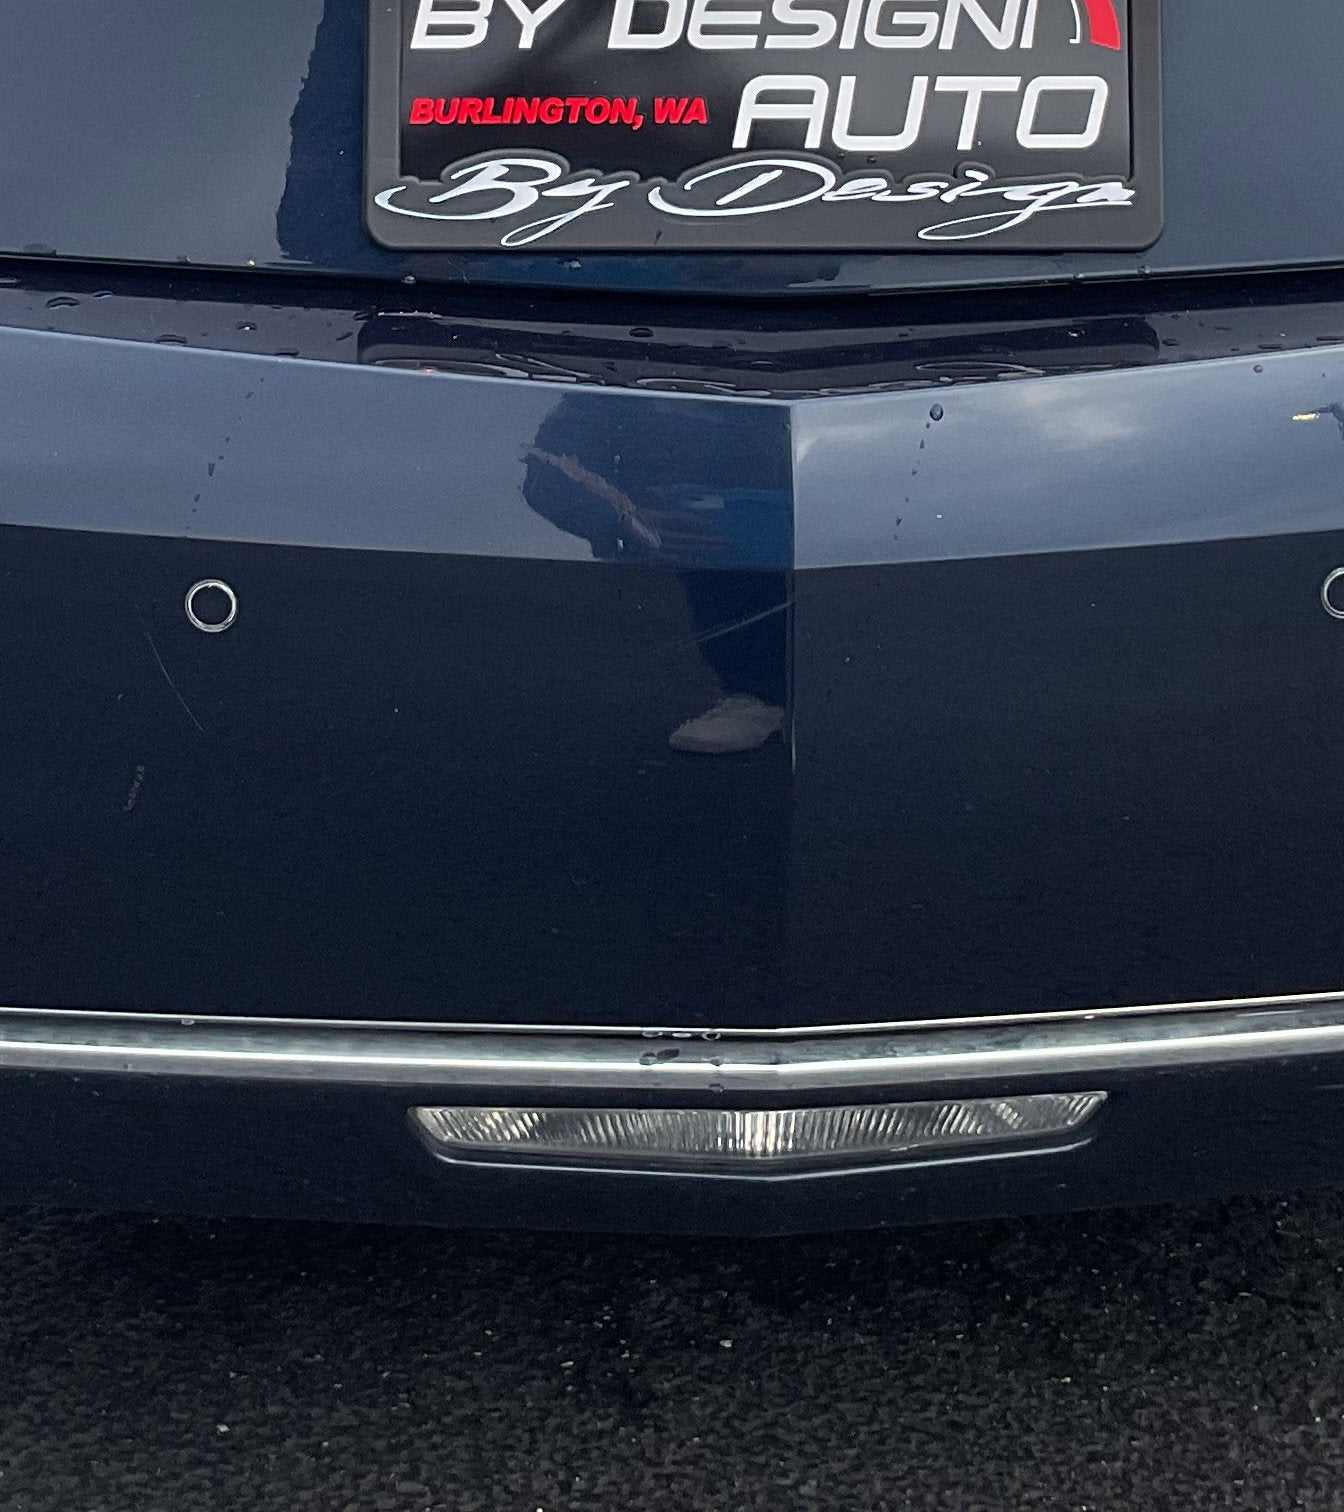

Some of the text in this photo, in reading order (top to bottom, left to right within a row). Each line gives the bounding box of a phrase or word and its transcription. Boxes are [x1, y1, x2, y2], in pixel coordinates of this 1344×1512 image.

[409, 97, 709, 131] BURLINGTON, WA
[730, 74, 1109, 151] AUTO
[374, 158, 1137, 248] By Design
